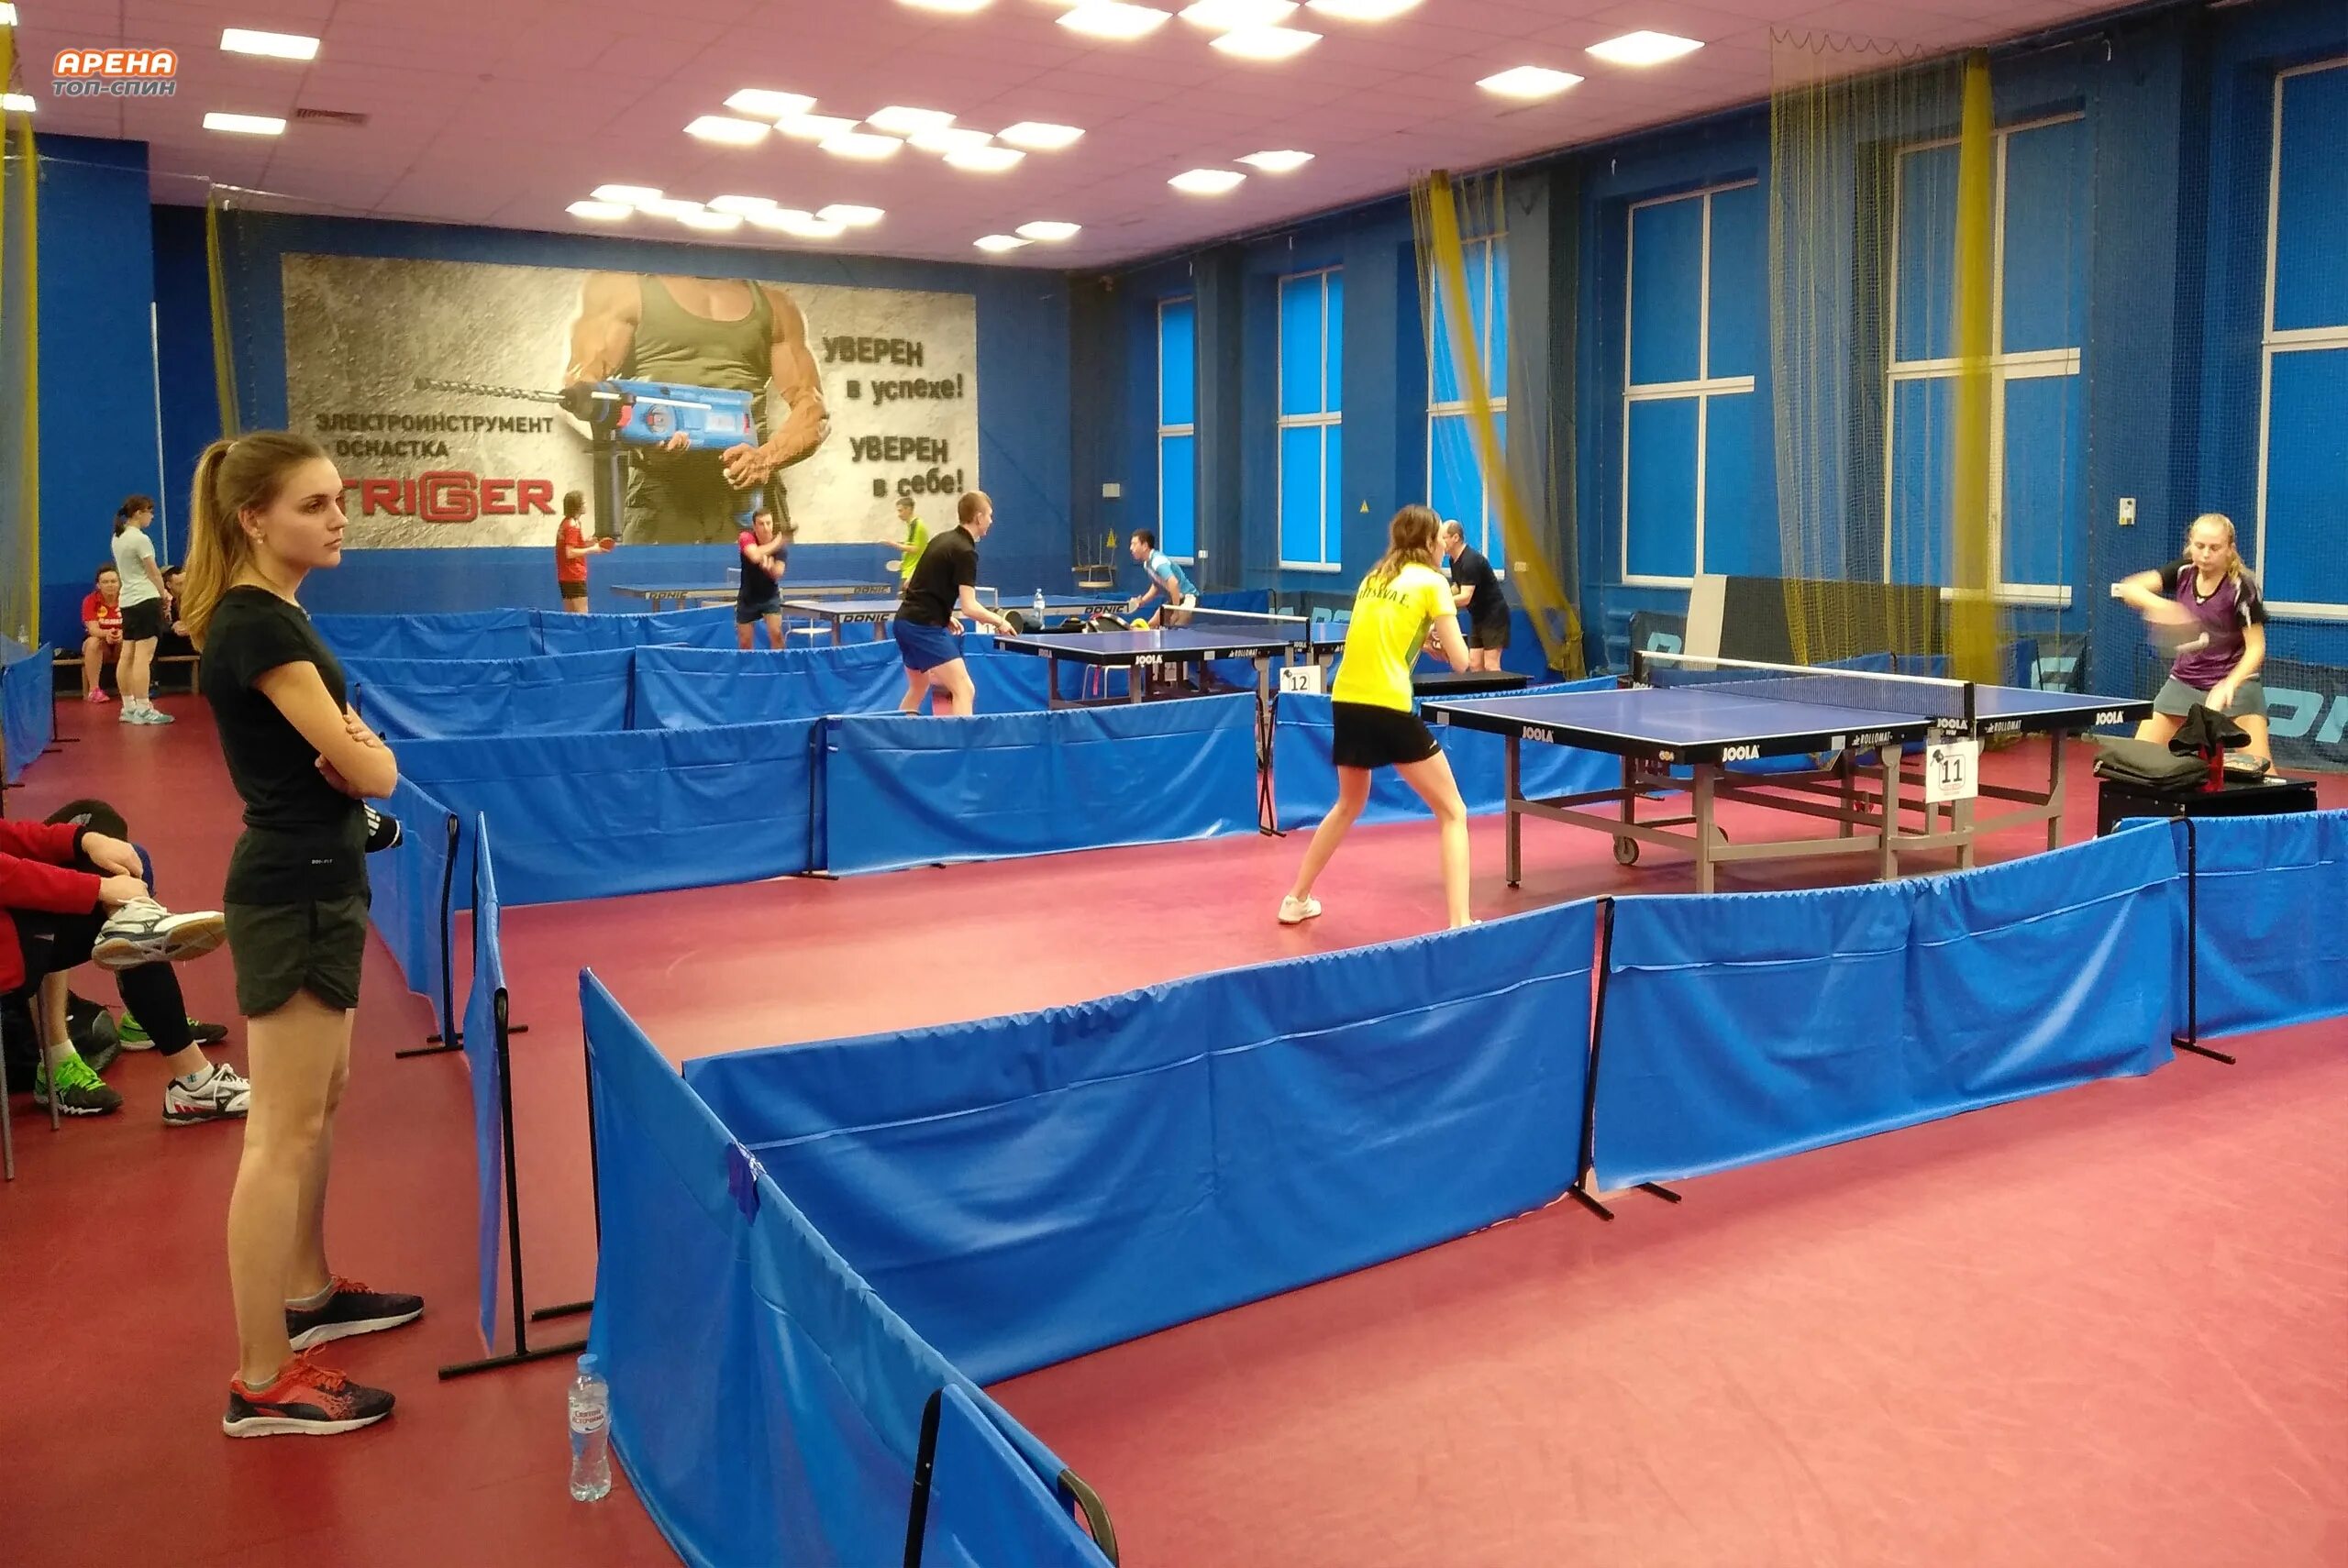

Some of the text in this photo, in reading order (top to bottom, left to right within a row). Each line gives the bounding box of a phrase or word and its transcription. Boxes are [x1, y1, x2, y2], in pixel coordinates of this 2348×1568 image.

[823, 336, 924, 367] УВЕРЕН
[847, 373, 963, 406] в успехе!
[316, 413, 554, 434] ЭЛЕКТРОИНСТРУМЕНТ
[336, 439, 449, 458] ОСНАСТКА
[849, 436, 948, 463] УВЕРЕН
[873, 468, 963, 497] в себе!
[843, 613, 891, 624] DONIC
[1084, 605, 1125, 614] DONIC
[1135, 654, 1163, 666] JOOLA
[1290, 676, 1308, 691] 12
[1936, 718, 1968, 730] JOOLA
[1994, 719, 2022, 733] ROLLOMAT
[2095, 711, 2124, 726] JOOLA
[1522, 725, 1555, 744] JOOLA
[1860, 731, 1891, 745] ROLLOMAT
[1722, 744, 1759, 763] JOOLA
[1942, 759, 1963, 784] 11
